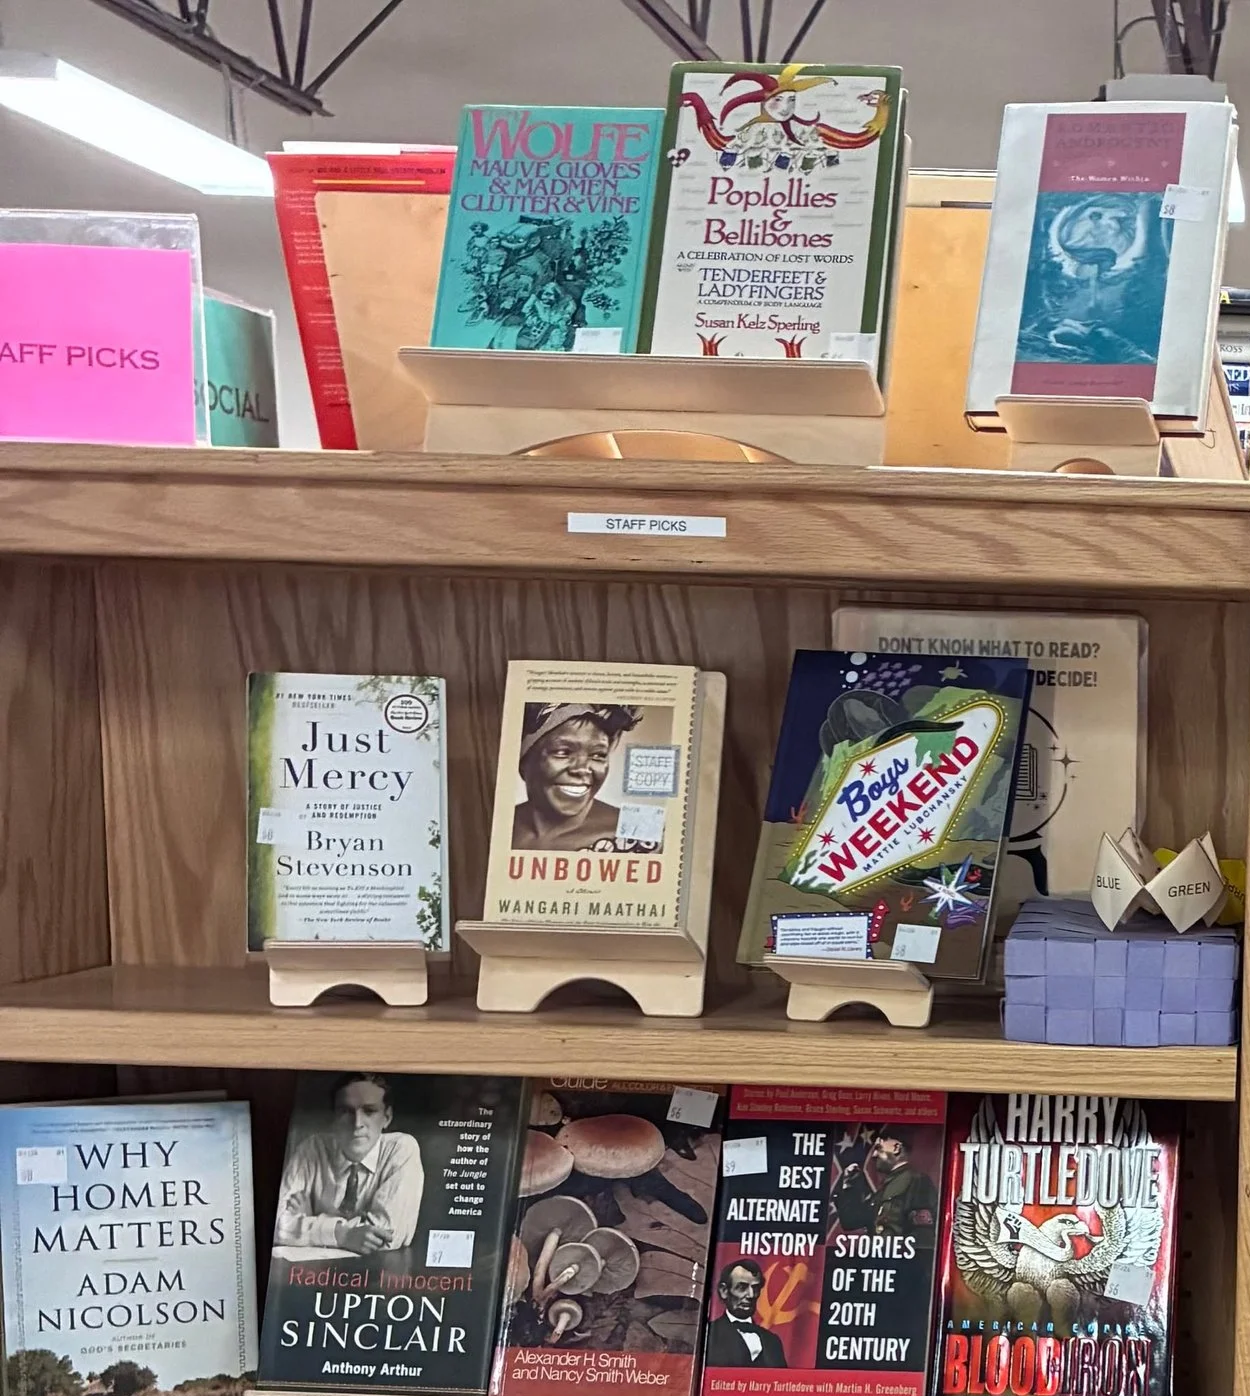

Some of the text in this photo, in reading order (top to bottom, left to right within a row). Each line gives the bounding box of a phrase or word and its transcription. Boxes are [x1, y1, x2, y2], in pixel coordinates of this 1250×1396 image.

[471, 110, 650, 162] WOLFE
[708, 176, 838, 211] Poplollies
[772, 209, 792, 231] &
[704, 219, 833, 248] Bellibones
[677, 251, 854, 264] A CELEBRATION OF LOST WORDS
[695, 313, 820, 334] Susan Kelz Sperling
[66, 346, 160, 370] PICKS
[606, 518, 687, 532] STAFF PICKS
[878, 637, 1101, 660] DON'T KNOW WHAT TO READ?
[1036, 670, 1098, 688] DECIDE!
[301, 719, 391, 755] Just
[279, 757, 414, 802] Mercy
[837, 755, 910, 823] Boys
[817, 734, 980, 884] WEEKEND
[862, 774, 969, 874] MATTIE LUBCHANSKY
[306, 830, 385, 858] Bryan
[276, 855, 413, 877] Stevenson
[508, 856, 663, 884] UNBOWED
[1096, 875, 1122, 891] BLUE
[1168, 880, 1212, 899] GREEN
[499, 899, 666, 918] WANGARI MAATHAI
[75, 1140, 179, 1171] WHY
[793, 1133, 825, 1157] THE
[778, 1166, 823, 1190] BEST
[51, 1181, 210, 1213] HOMER
[448, 1207, 482, 1216] America
[726, 1199, 820, 1224] ALTERNATE
[32, 1218, 225, 1254] MATTERS
[740, 1232, 819, 1257] HISTORY
[834, 1235, 916, 1260] STORIES
[77, 1270, 186, 1297] ADAM
[288, 1265, 473, 1292] Radical Innocent
[832, 1269, 896, 1294] OF THE
[37, 1299, 225, 1333] NICOLSON
[314, 1293, 446, 1323] UPTON
[828, 1302, 877, 1327] 20TH
[280, 1321, 466, 1354] SINCLAIR
[825, 1337, 911, 1363] CENTURY
[321, 1360, 423, 1378] Anthony Arthur
